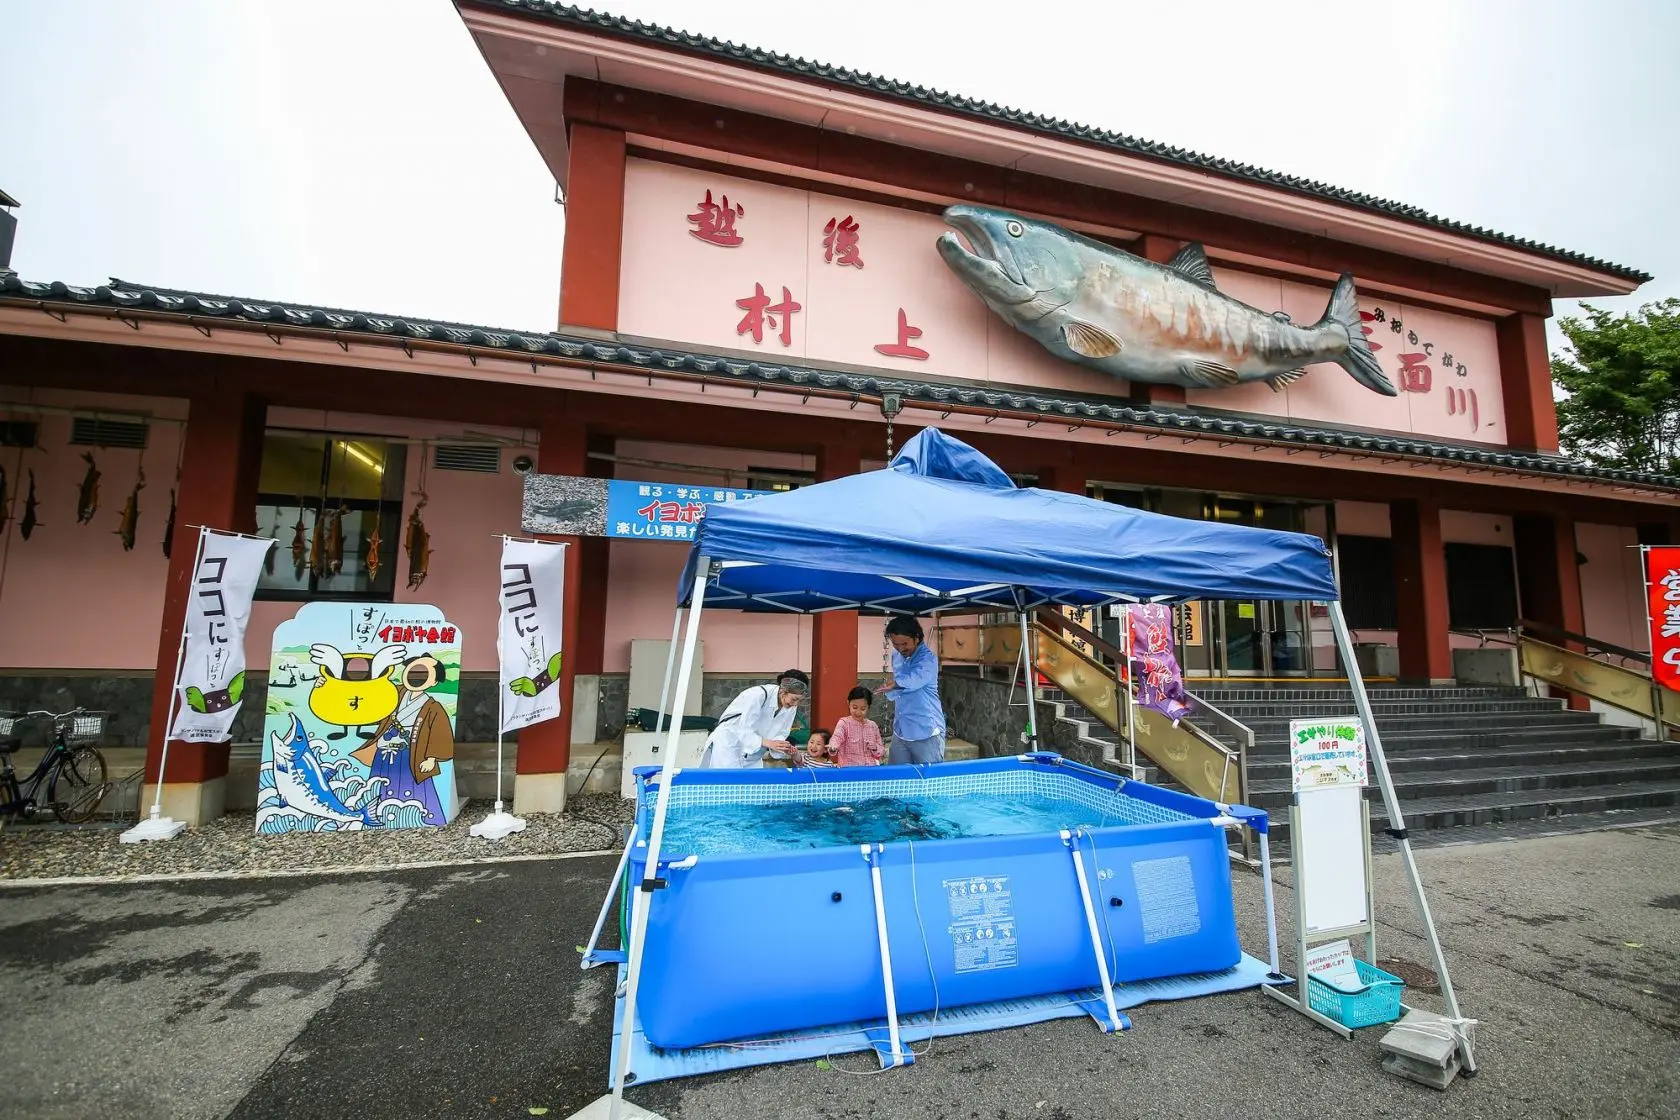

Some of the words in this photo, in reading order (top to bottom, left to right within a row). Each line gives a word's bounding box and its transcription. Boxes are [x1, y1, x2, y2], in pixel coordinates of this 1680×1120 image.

[687, 188, 865, 270] 越後
[735, 281, 930, 361] 村上
[199, 557, 228, 646] ココに
[378, 624, 456, 644] イヨボヤ会館
[503, 563, 539, 638] ココに
[347, 695, 364, 711] す
